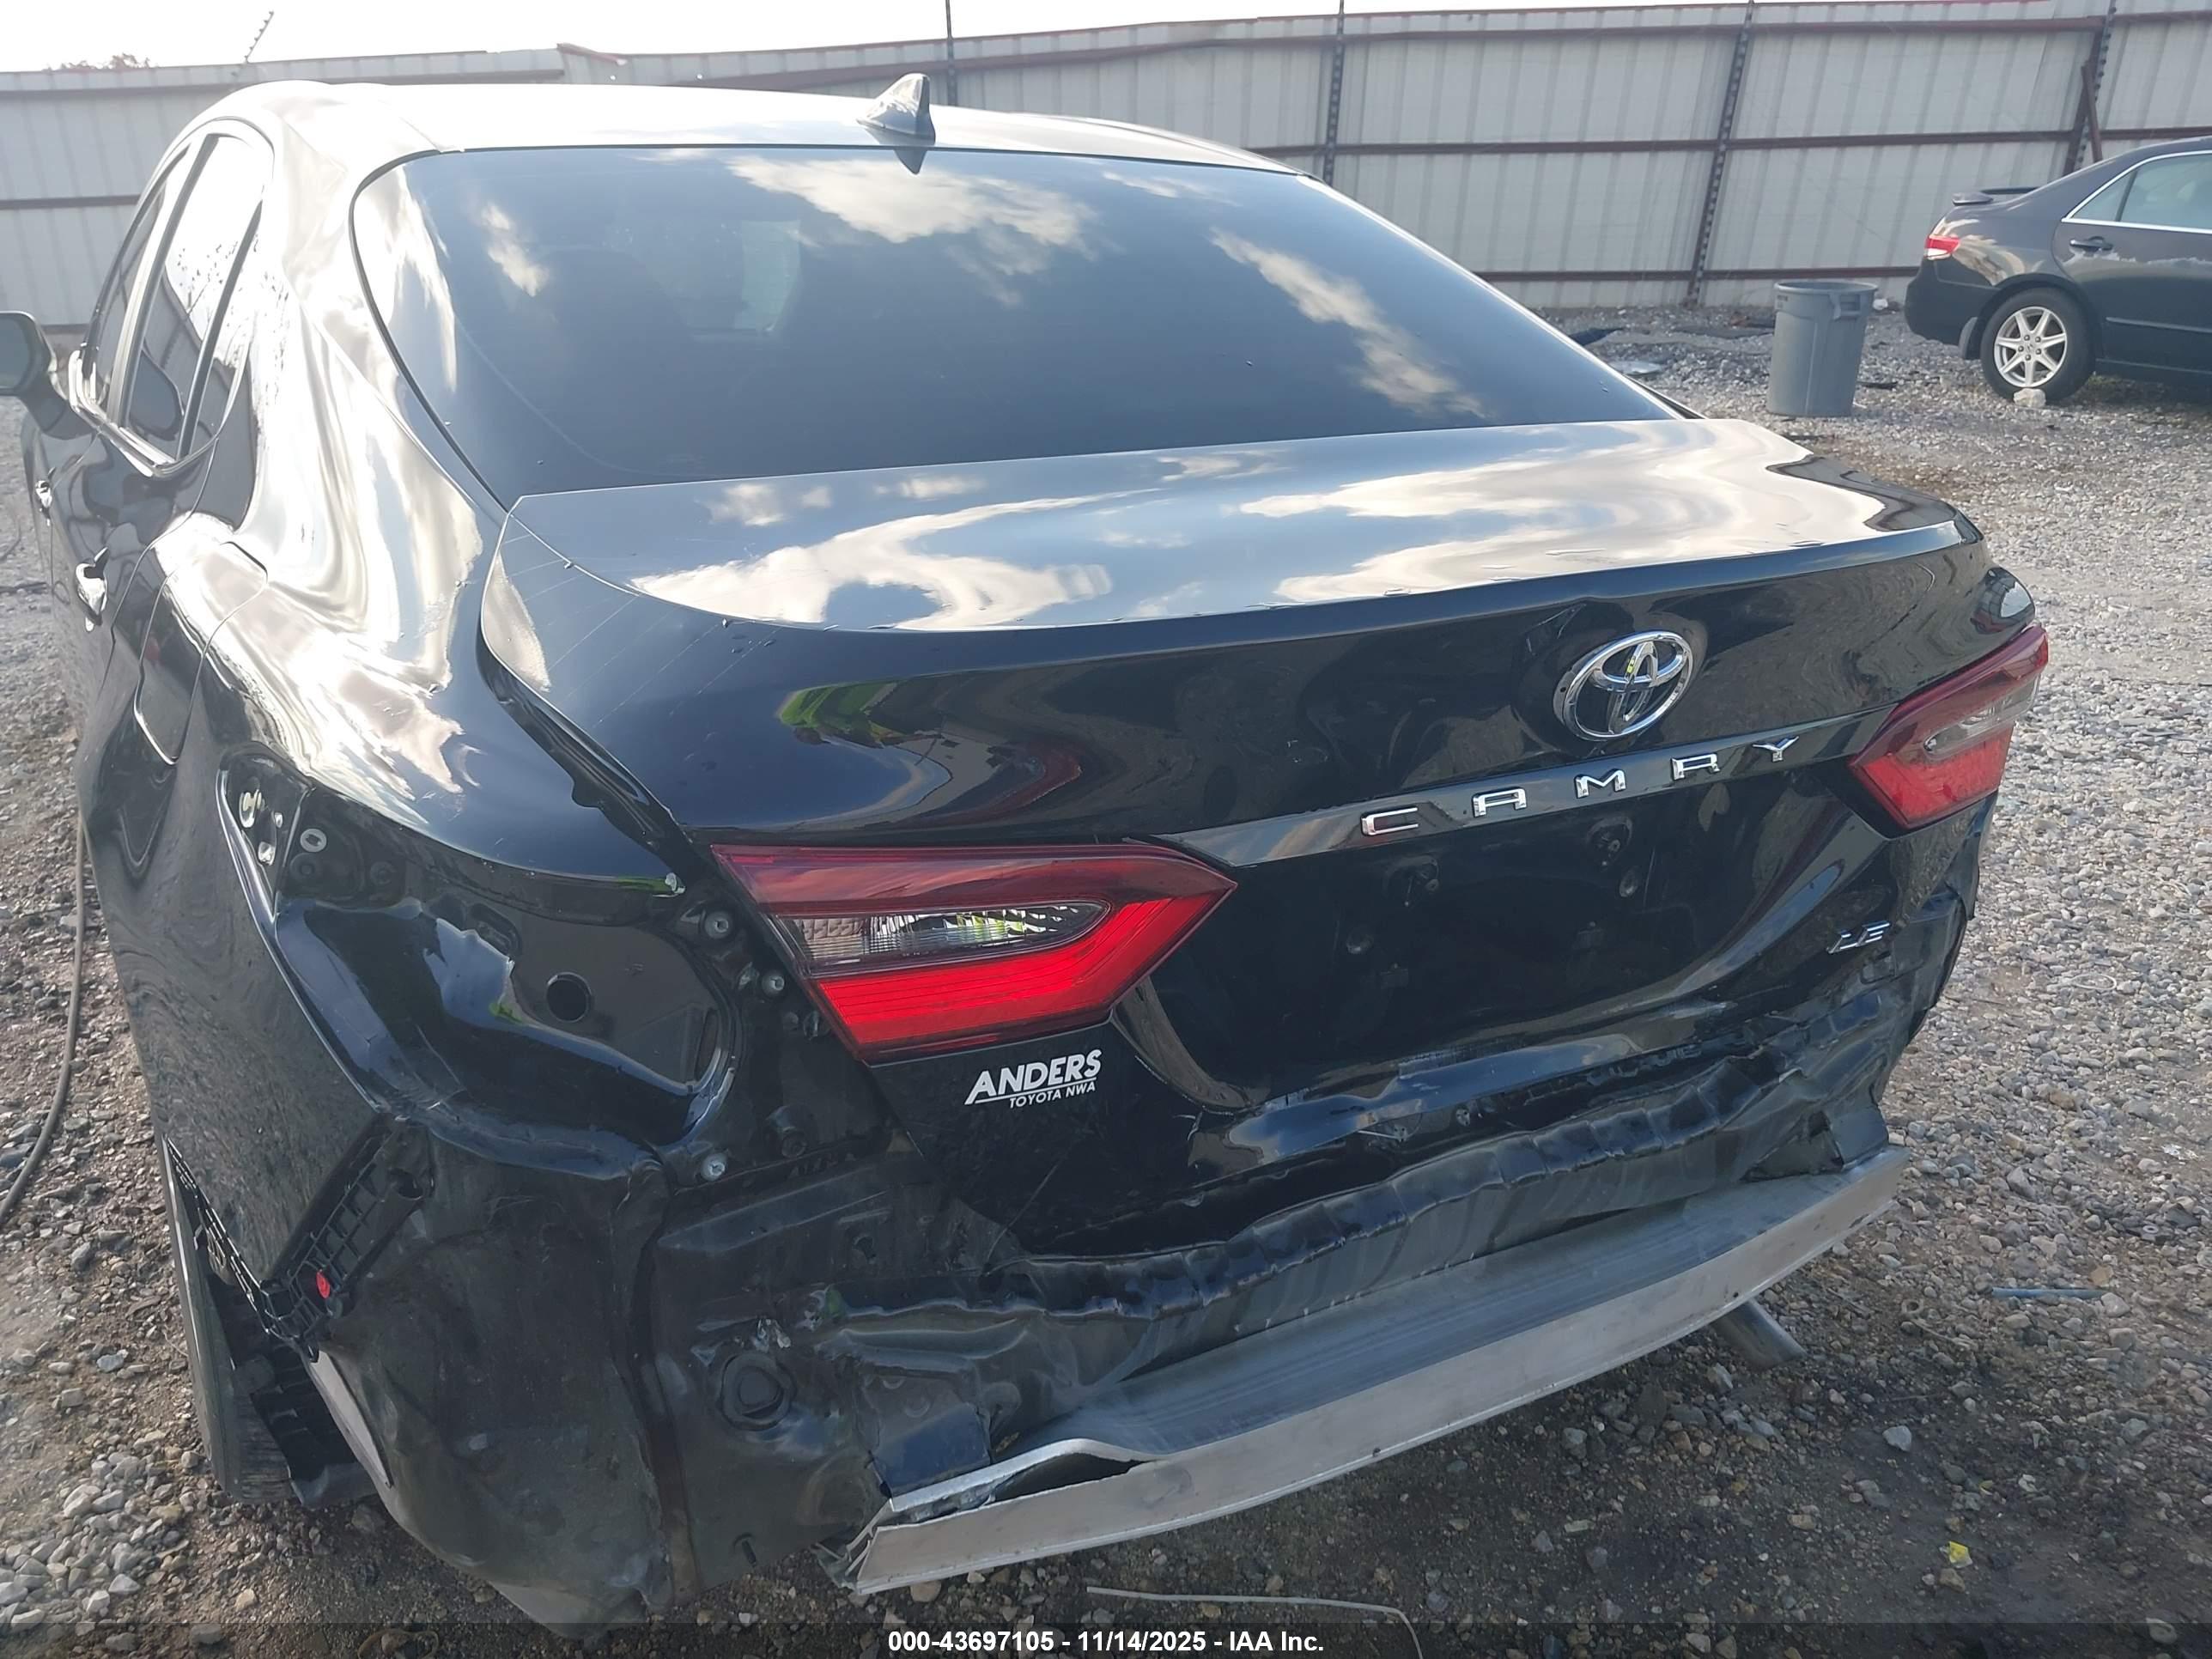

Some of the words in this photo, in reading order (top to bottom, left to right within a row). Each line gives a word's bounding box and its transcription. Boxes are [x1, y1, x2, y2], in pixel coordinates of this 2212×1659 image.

[1361, 736, 1800, 836] CAMRY
[1826, 921, 1891, 954] LE
[964, 1048, 1102, 1105] ANDERS
[1009, 1090, 1061, 1109] TOYOTA
[1065, 1081, 1096, 1097] NWA
